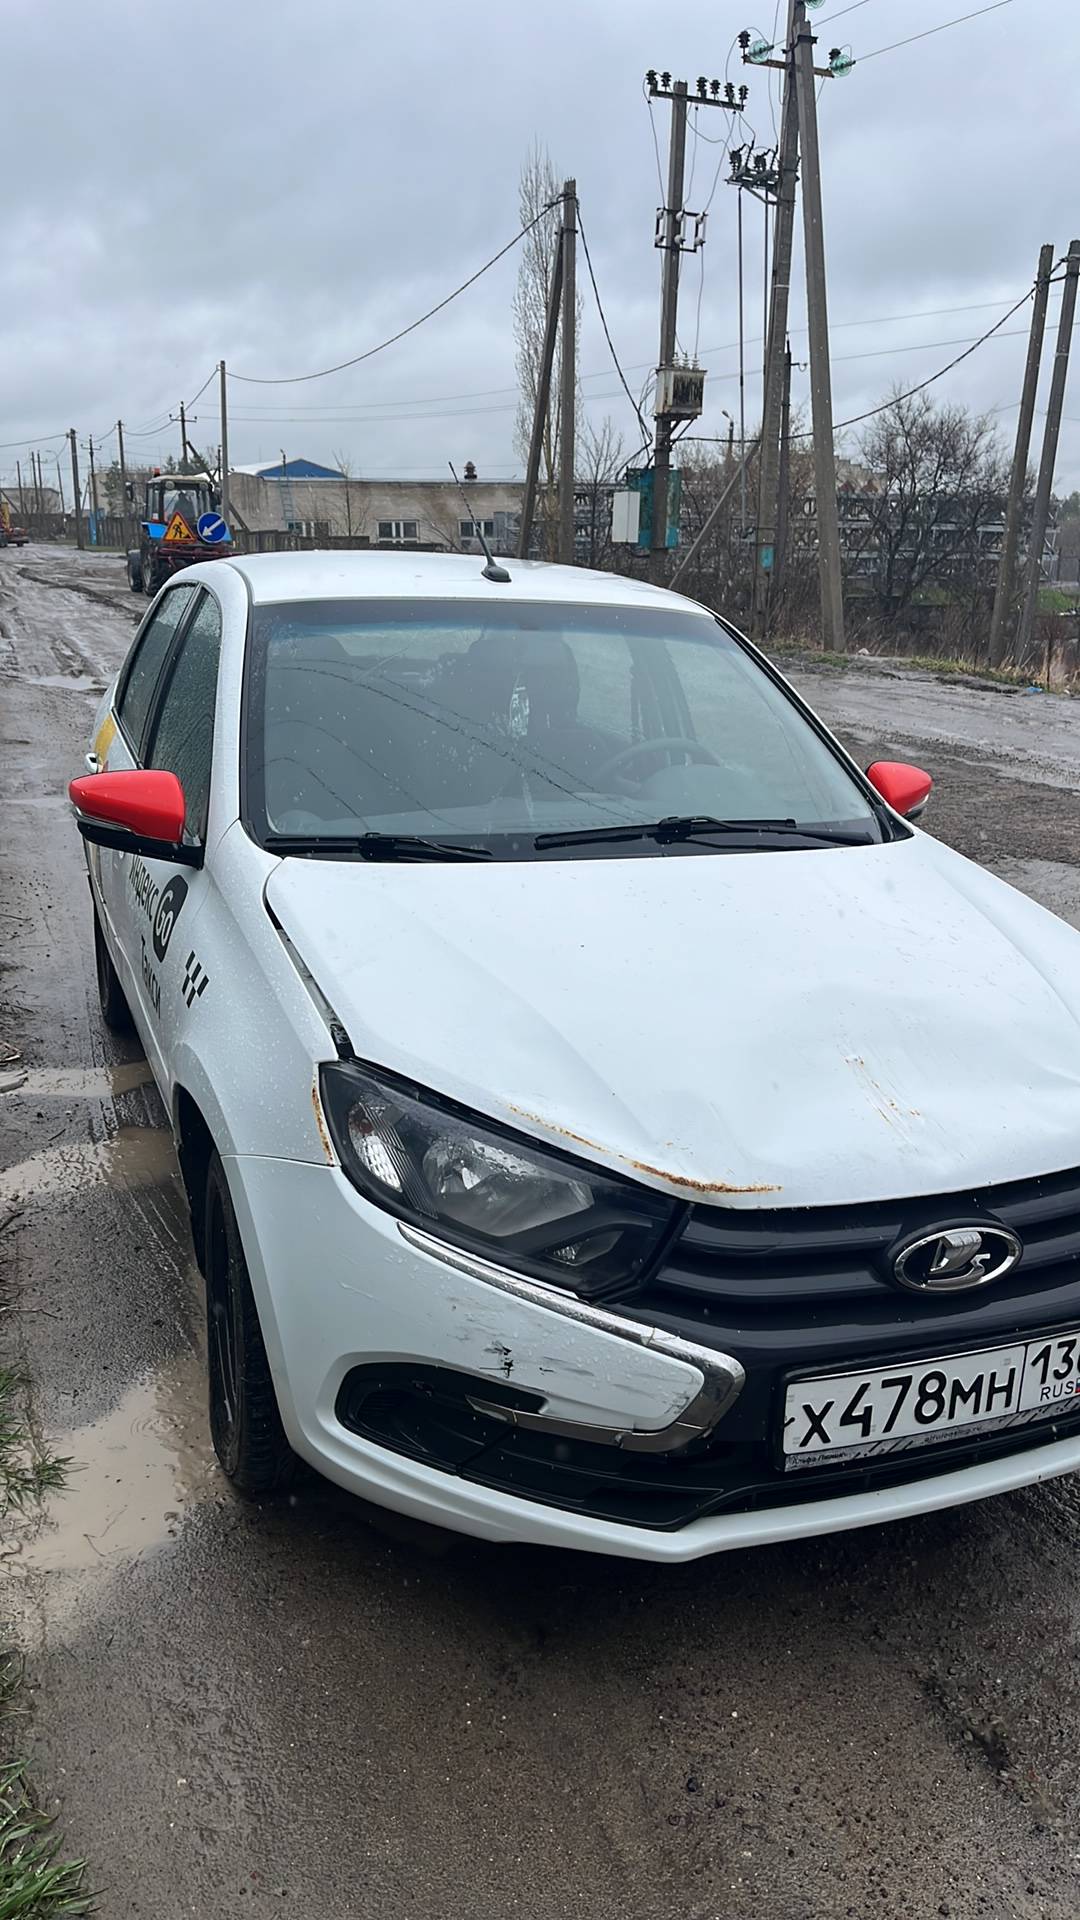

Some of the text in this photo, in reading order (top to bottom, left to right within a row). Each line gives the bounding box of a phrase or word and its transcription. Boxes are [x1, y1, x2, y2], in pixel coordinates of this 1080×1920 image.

[155, 889, 174, 947] Go
[799, 1338, 1080, 1448] Х478МН 13
[1040, 1381, 1074, 1402] RUS
